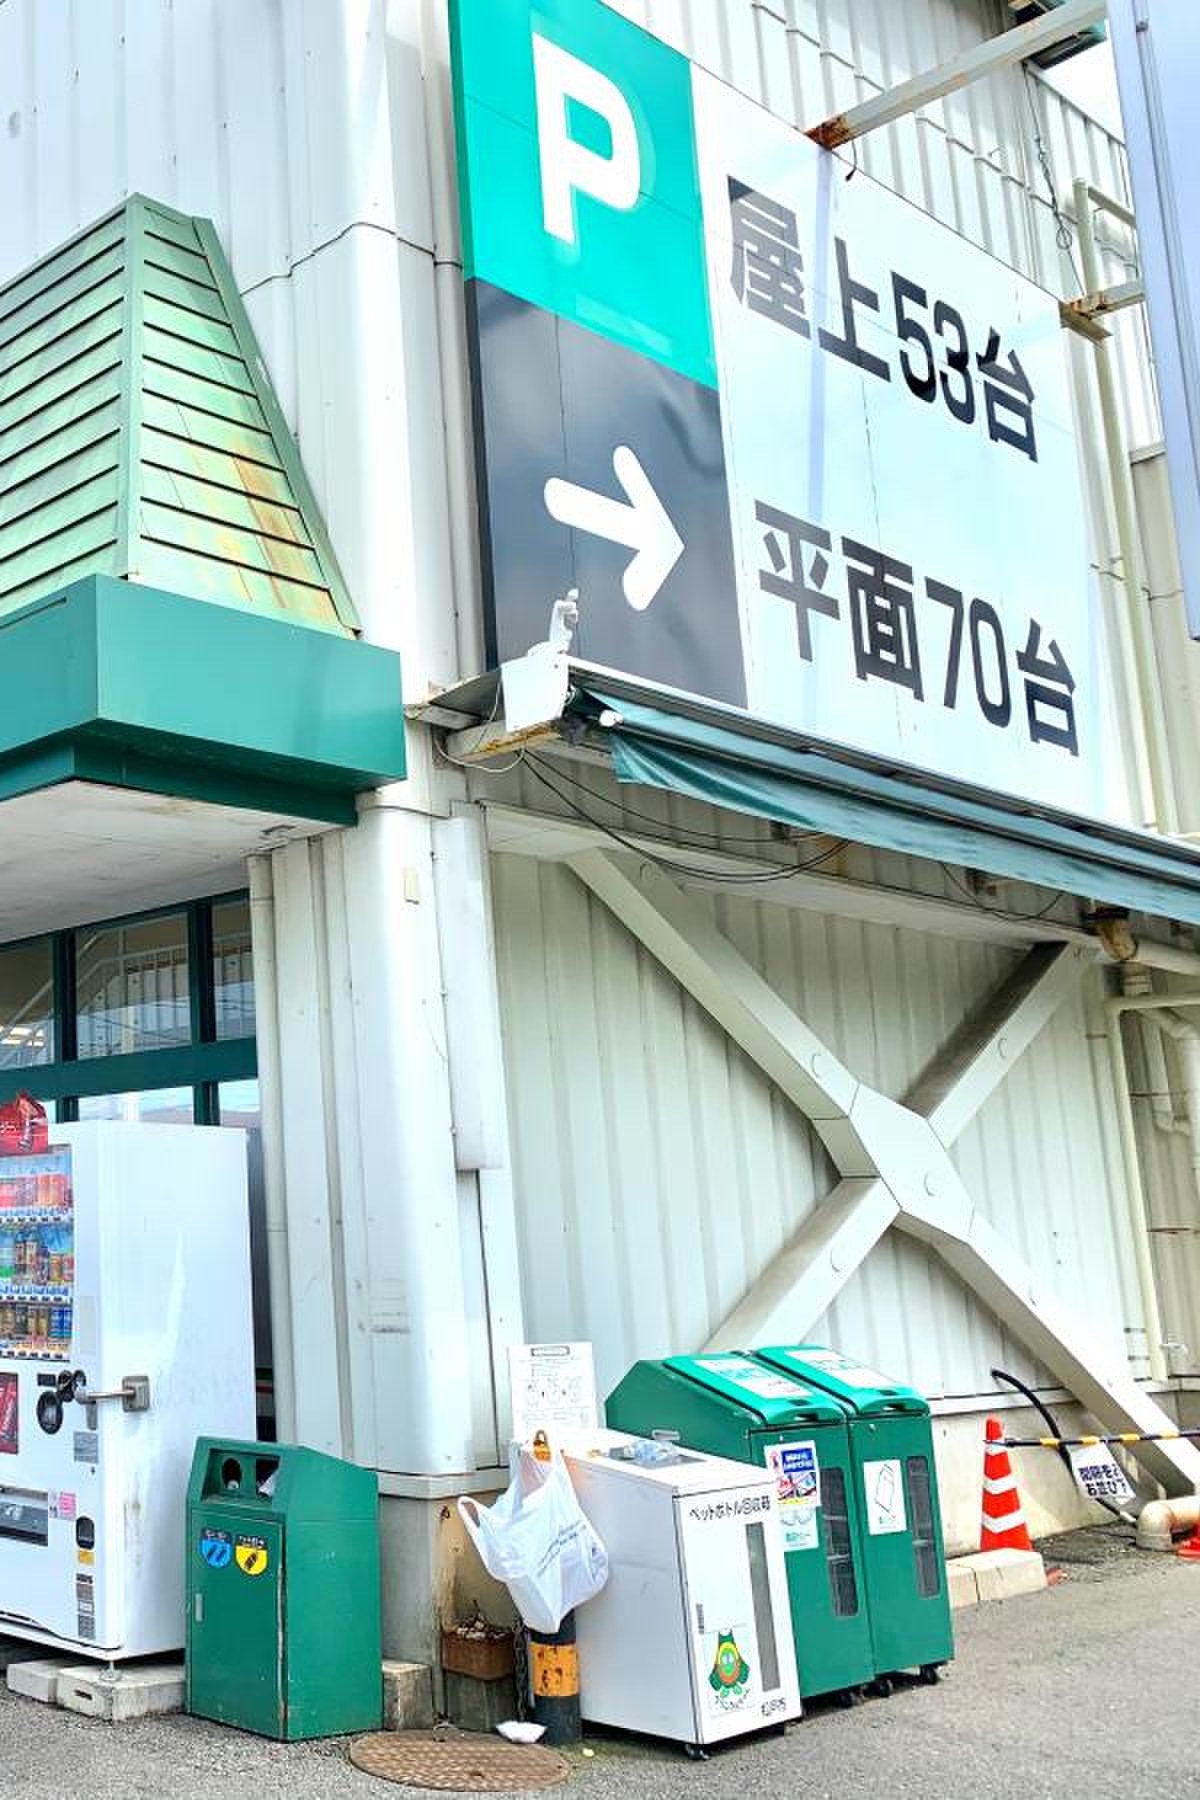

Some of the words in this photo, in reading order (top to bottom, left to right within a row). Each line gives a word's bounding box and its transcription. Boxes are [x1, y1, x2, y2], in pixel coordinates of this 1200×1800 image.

[531, 30, 641, 246] P
[726, 174, 1040, 465] 屋上53台
[753, 498, 1080, 758] 平面70台
[688, 1495, 771, 1522] ペットボトル回収箱
